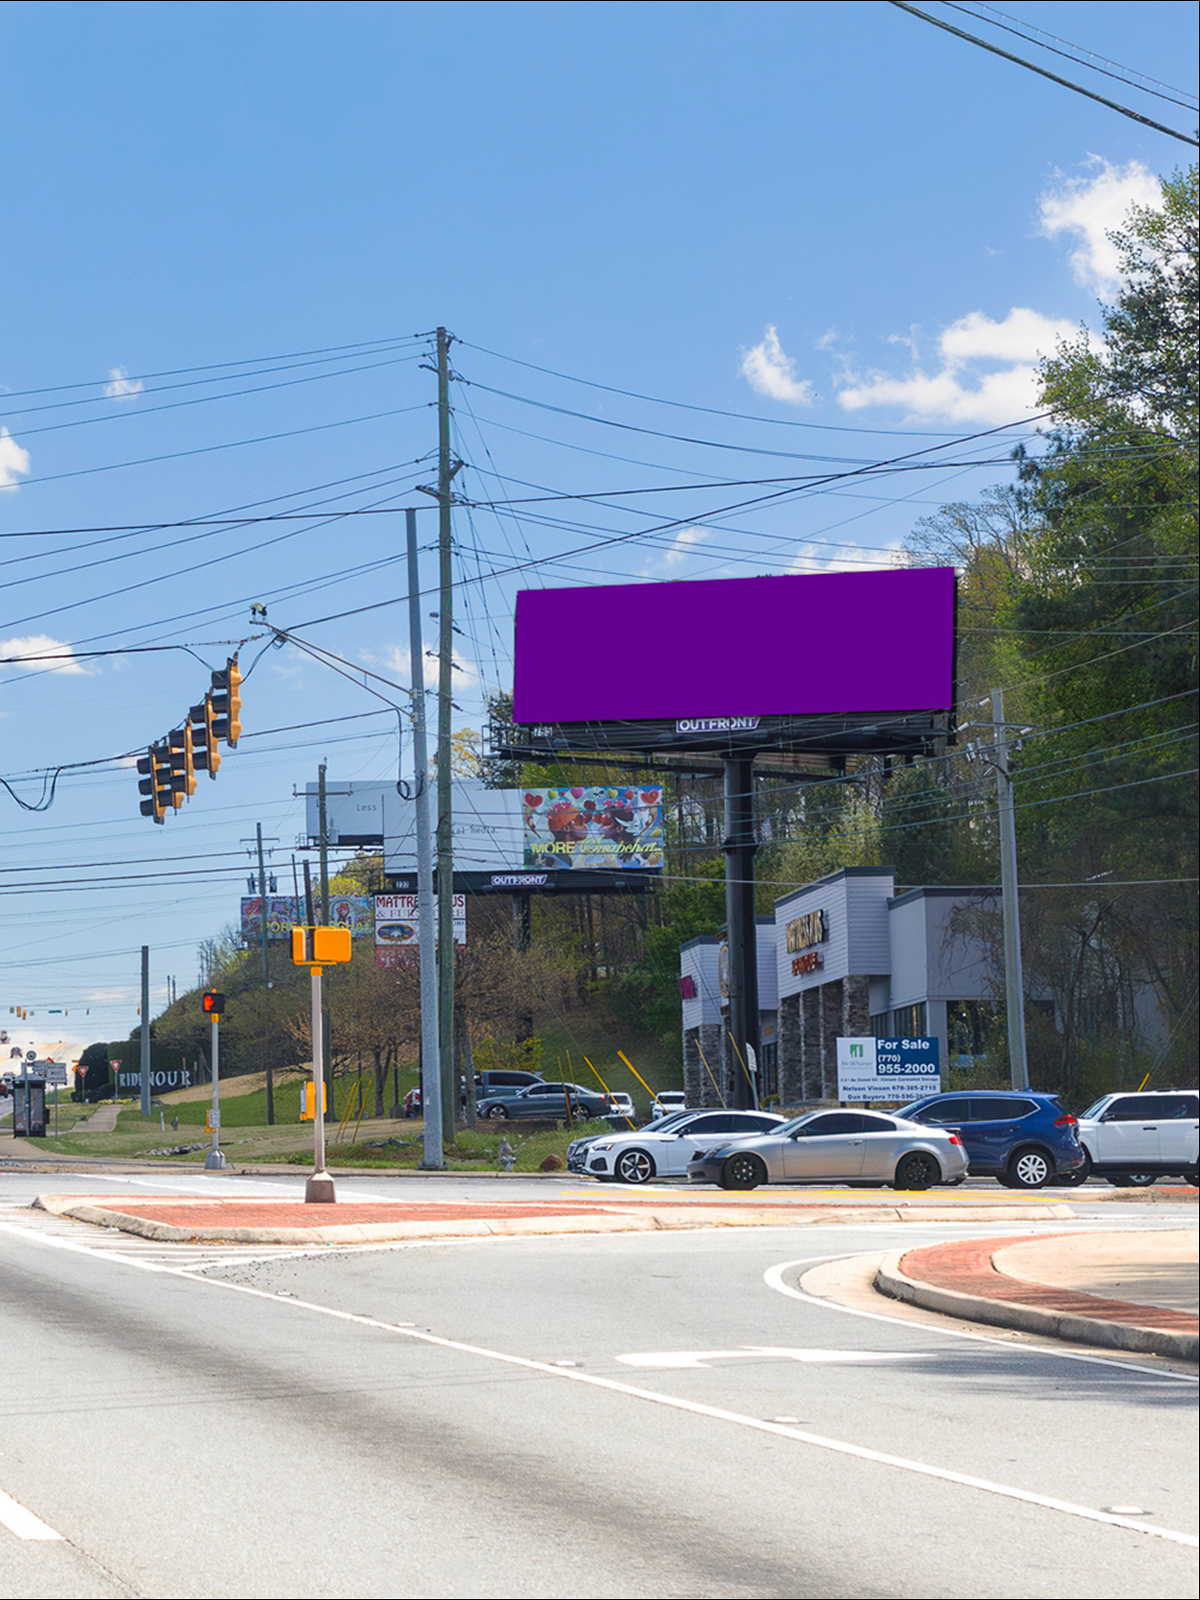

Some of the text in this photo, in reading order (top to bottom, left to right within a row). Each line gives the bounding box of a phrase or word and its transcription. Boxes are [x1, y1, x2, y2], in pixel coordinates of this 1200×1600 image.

[680, 716, 754, 731] OUTFRONT
[531, 841, 576, 854] MORE
[493, 875, 545, 885] OUTFRONT
[376, 895, 425, 908] MATTRE
[877, 1039, 930, 1049] For Sale
[877, 1054, 901, 1063] (770)
[878, 1063, 936, 1074] 955-2000
